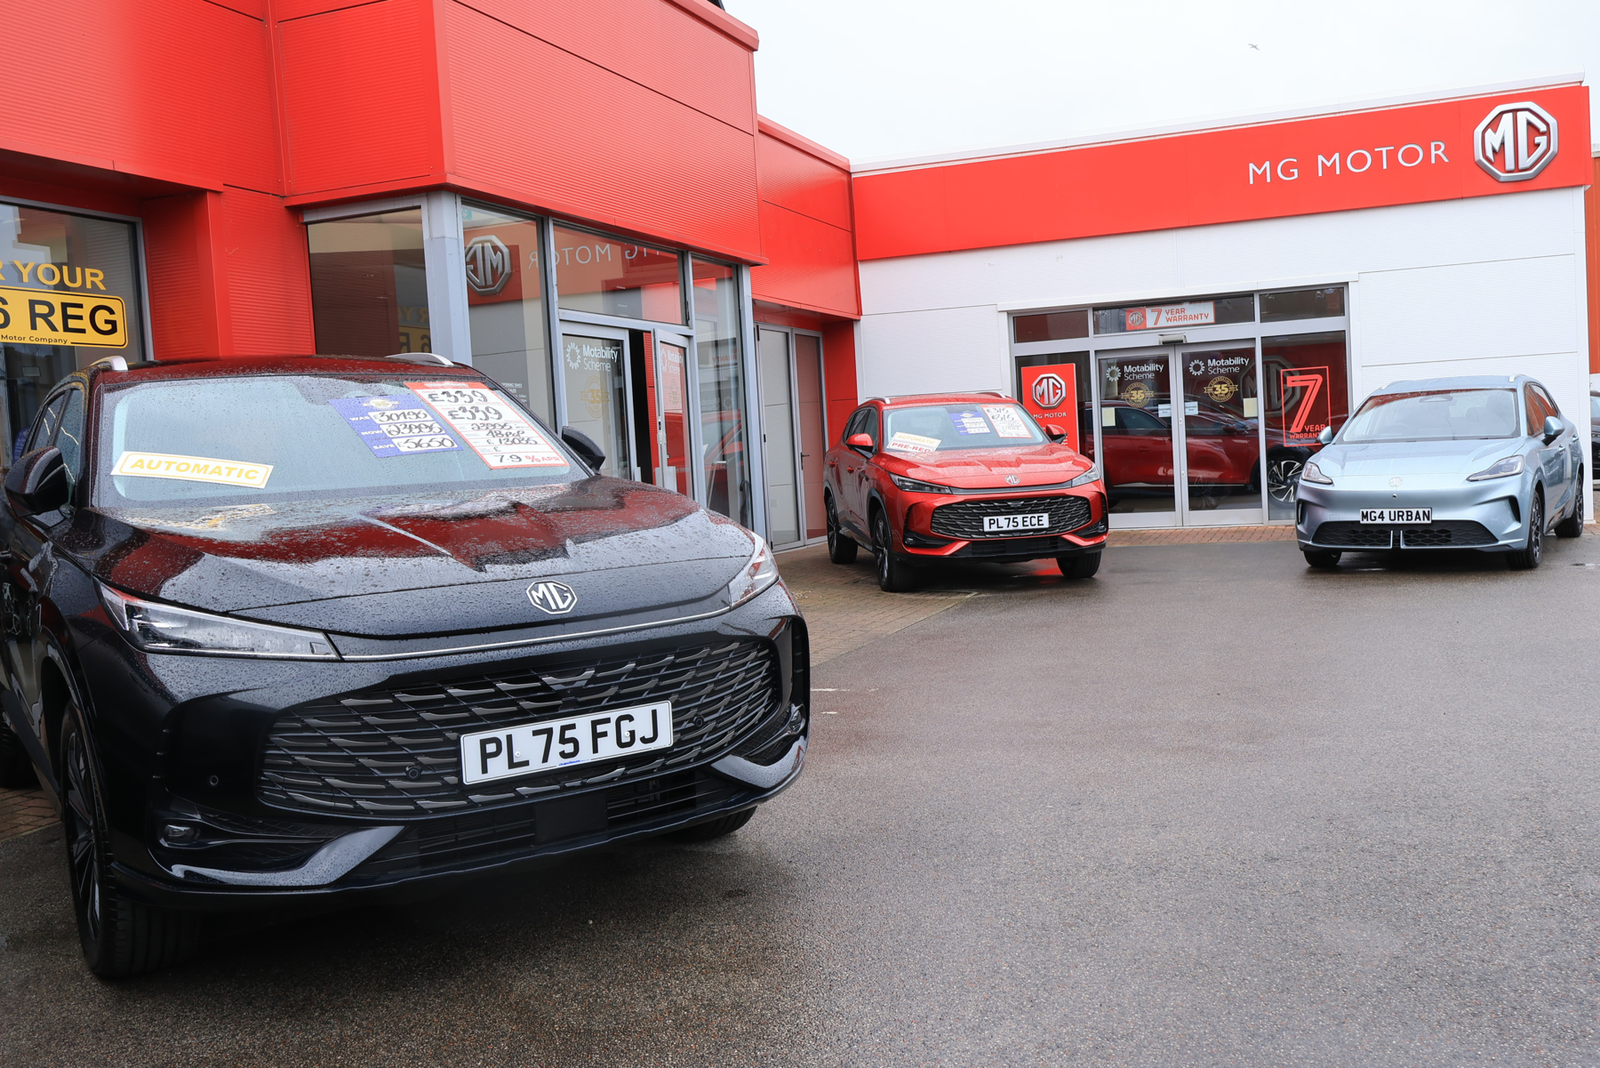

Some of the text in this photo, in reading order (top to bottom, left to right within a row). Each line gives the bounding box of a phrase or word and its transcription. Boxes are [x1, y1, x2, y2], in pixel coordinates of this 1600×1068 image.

[1484, 110, 1549, 172] MG
[1248, 140, 1450, 185] MG MOTOR
[13, 260, 107, 291] YOUR
[28, 299, 118, 336] REG
[1151, 307, 1186, 326] 7 YEAR
[1165, 313, 1210, 323] WARRANTY
[1, 334, 68, 345] Motor Company
[582, 344, 619, 363] Motability
[583, 357, 612, 373] Scheme
[1124, 363, 1164, 375] Motability
[1207, 356, 1250, 368] Motability
[1207, 365, 1240, 375] Scheme
[1124, 371, 1155, 381] Scheme
[1035, 378, 1062, 405] MG
[1130, 389, 1145, 400] 35
[1213, 383, 1229, 394] 35
[1286, 374, 1324, 433] 7
[897, 434, 937, 446] AUTOMATIC
[130, 458, 260, 480] AUTOMATIC
[1022, 515, 1045, 527] ECE
[1361, 510, 1431, 522] MG4 URBAN
[531, 582, 573, 610] MG
[590, 708, 660, 755] FGJ
